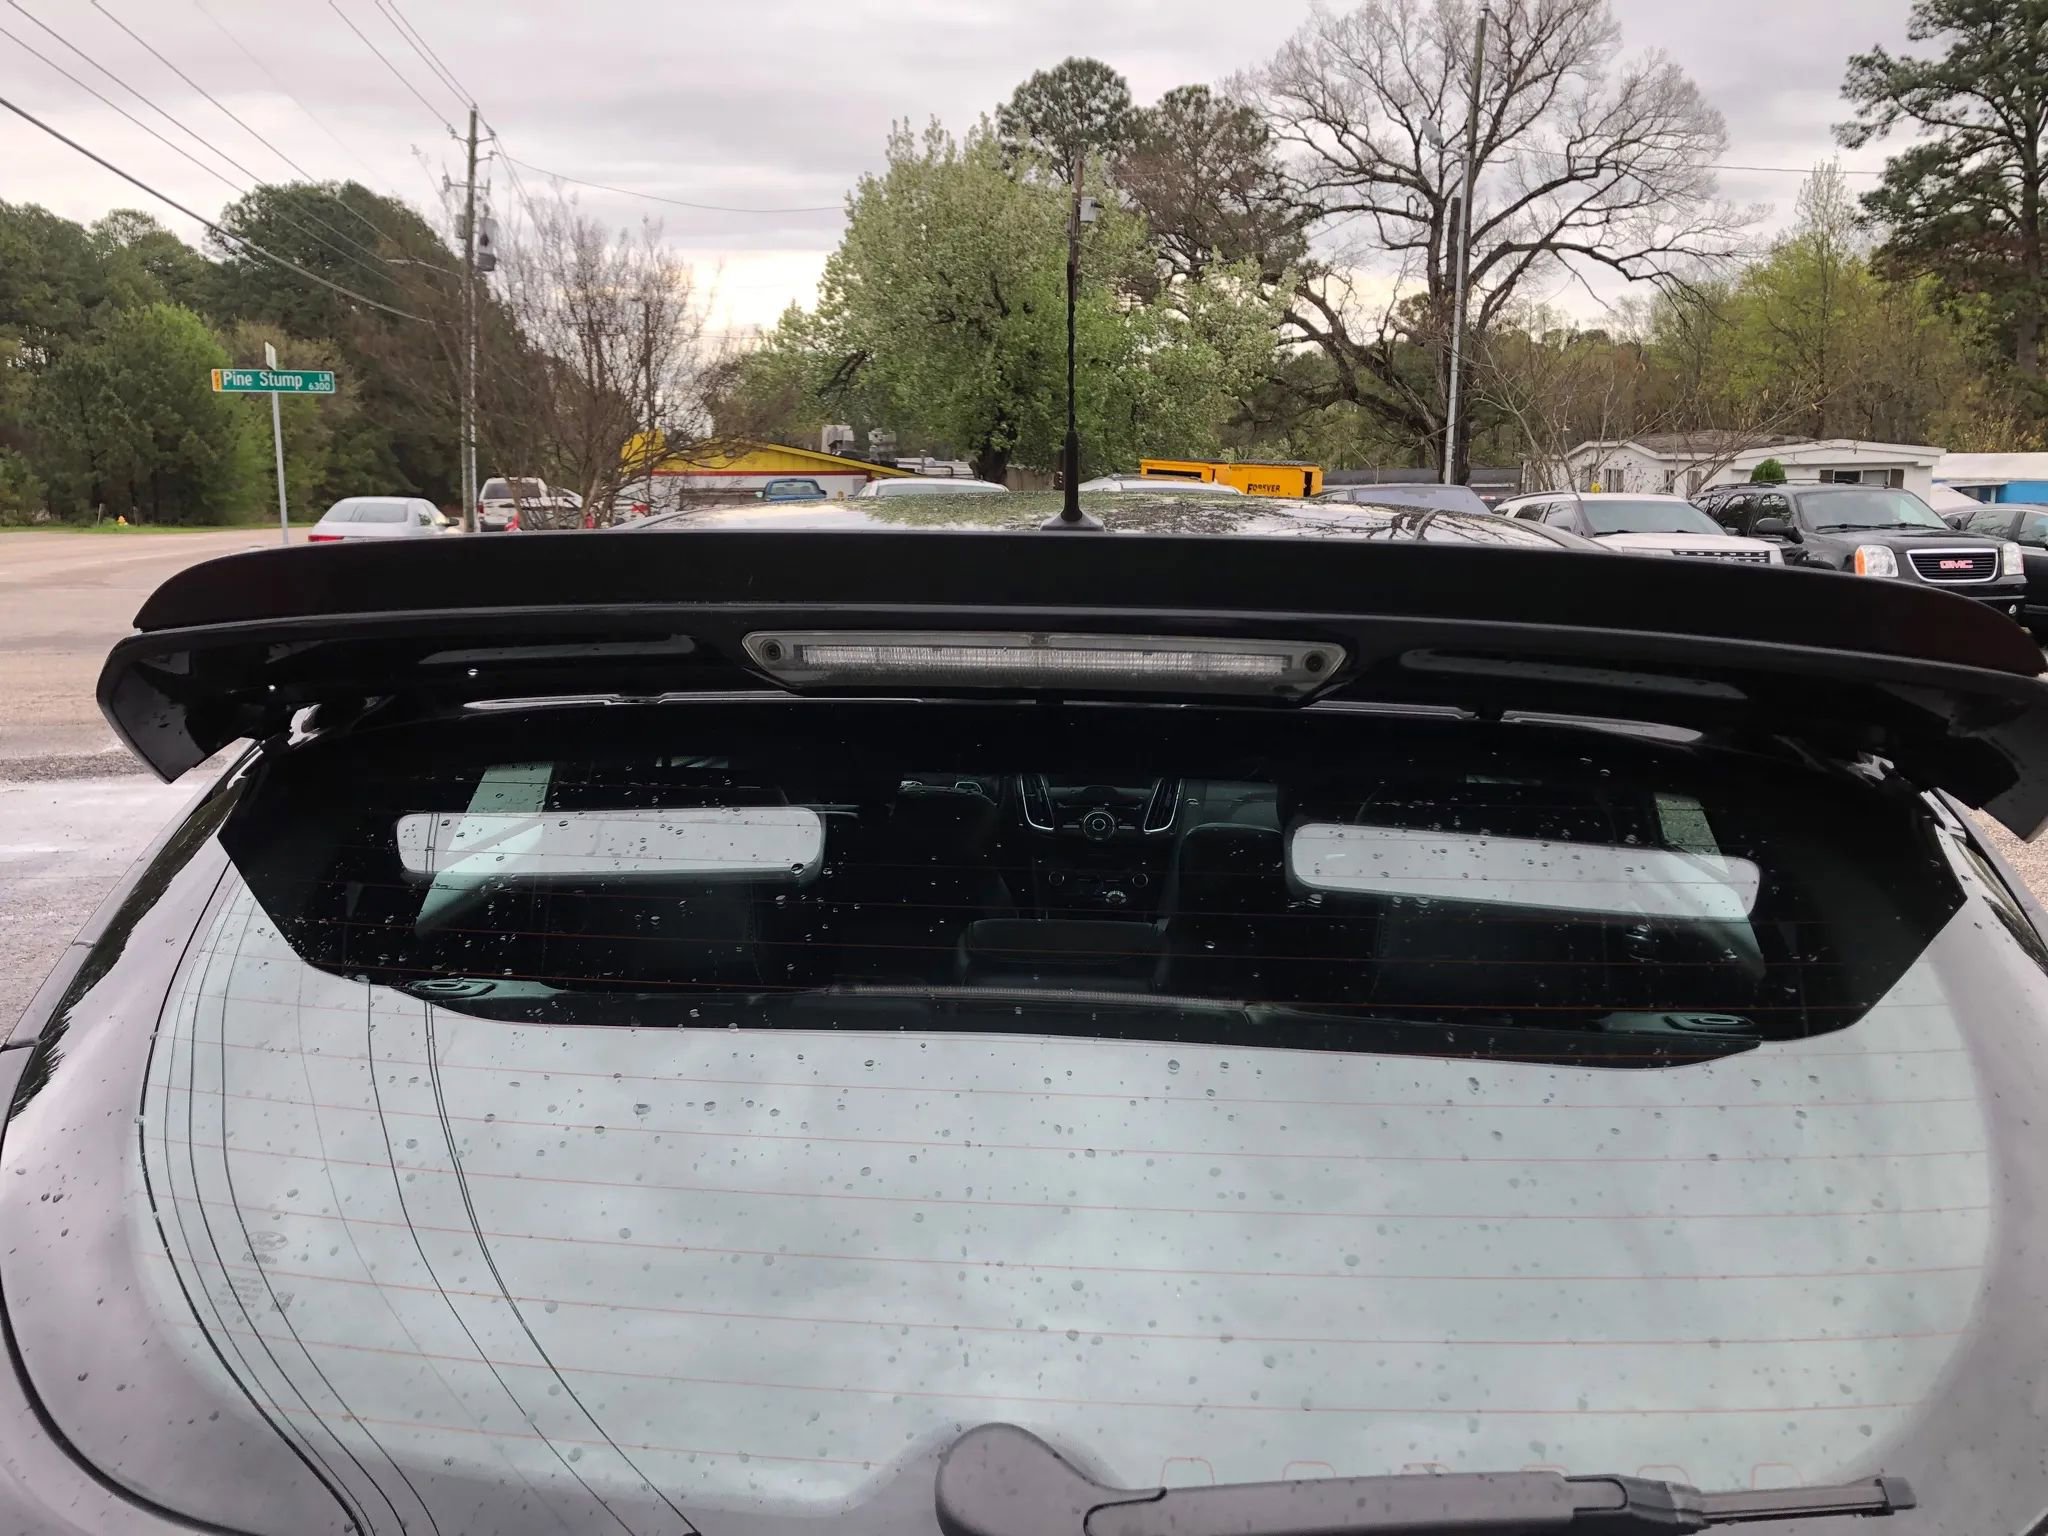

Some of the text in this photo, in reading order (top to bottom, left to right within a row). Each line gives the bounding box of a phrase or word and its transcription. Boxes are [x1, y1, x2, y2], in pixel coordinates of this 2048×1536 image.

[223, 371, 253, 386] Pine
[259, 372, 303, 390] Stump
[319, 373, 330, 382] LN
[308, 382, 331, 391] 6300
[1939, 560, 1974, 569] GMC
